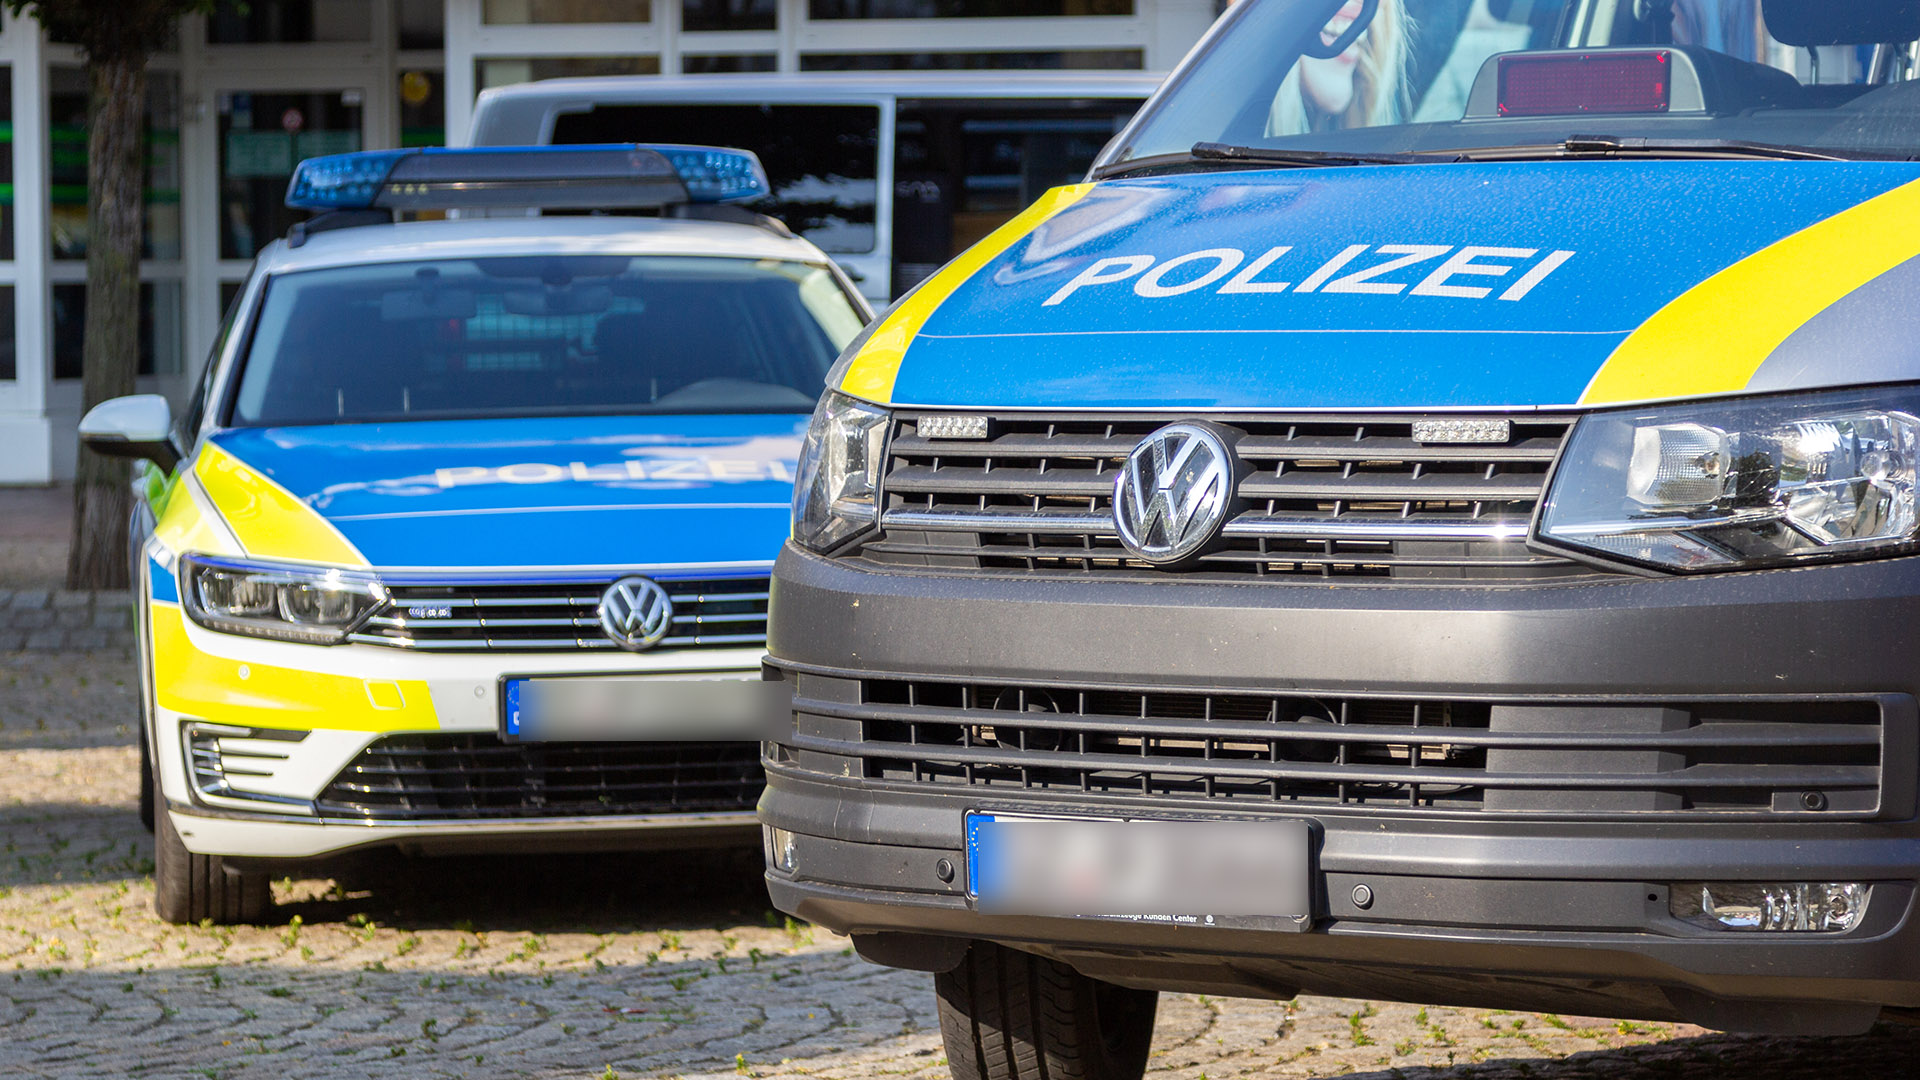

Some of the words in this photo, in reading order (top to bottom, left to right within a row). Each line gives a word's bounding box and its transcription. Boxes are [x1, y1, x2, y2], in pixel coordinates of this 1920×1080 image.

[1042, 244, 1576, 307] POLIZEI
[435, 460, 791, 488] POLIZEI
[1172, 914, 1197, 923] Center
